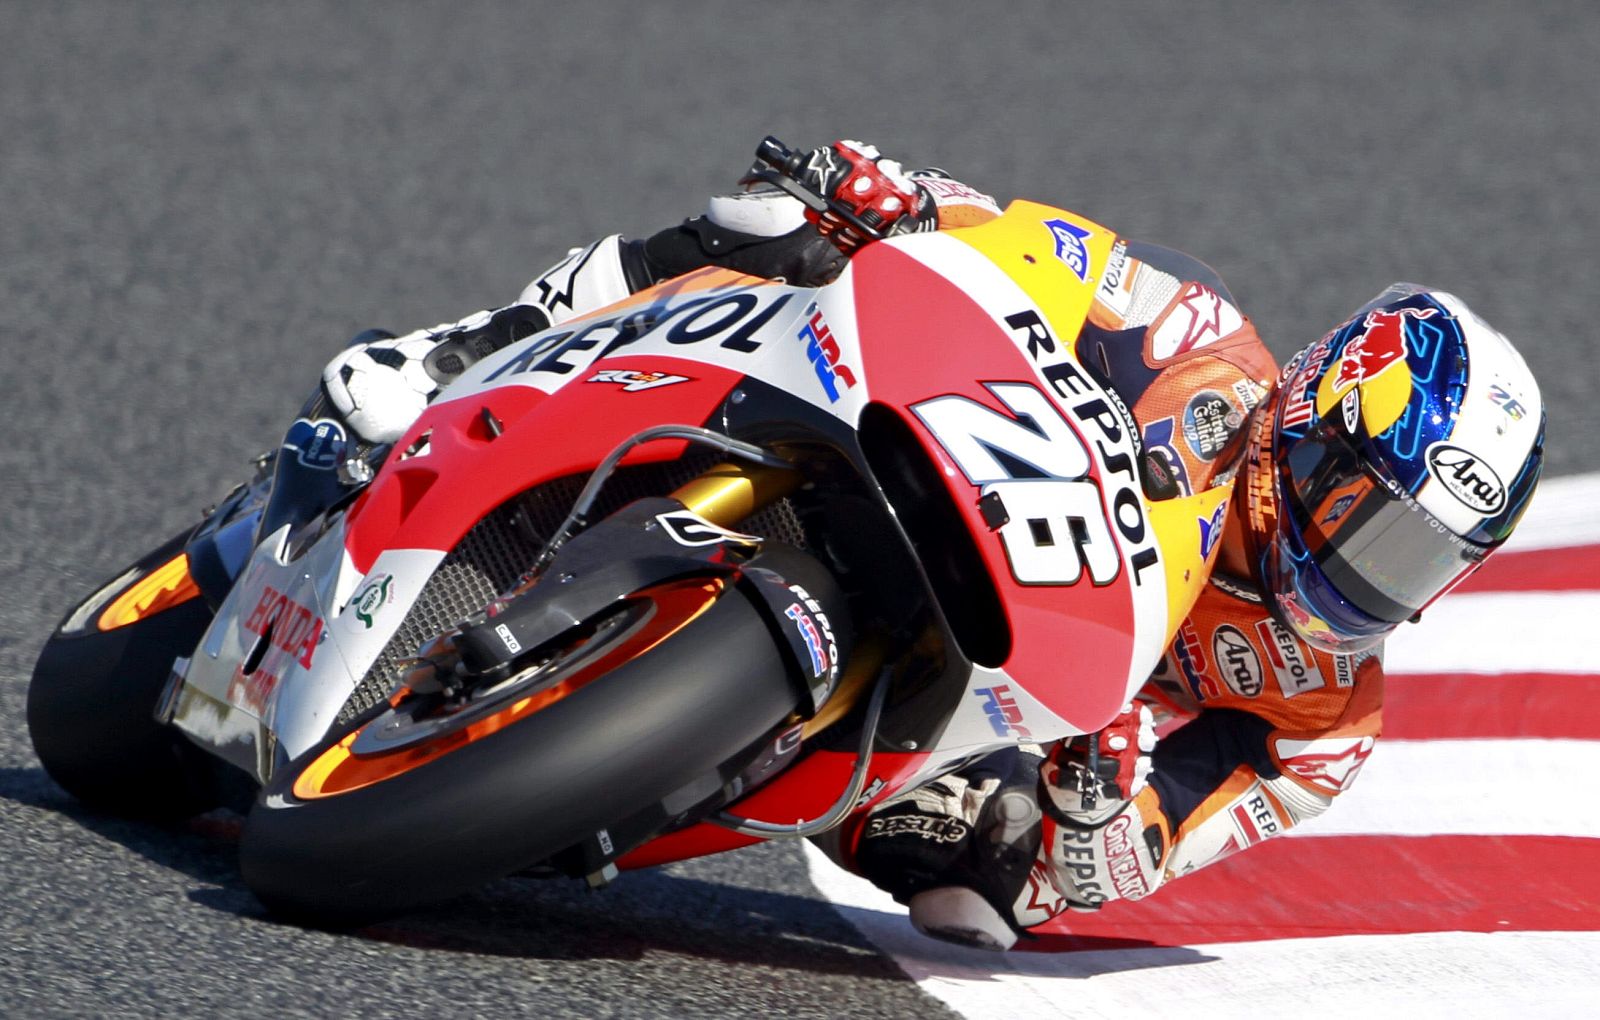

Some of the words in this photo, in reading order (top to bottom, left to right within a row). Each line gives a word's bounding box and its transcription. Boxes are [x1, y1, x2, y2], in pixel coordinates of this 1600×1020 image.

[798, 310, 858, 405] HRC
[1105, 386, 1142, 458] HONDA
[1193, 405, 1213, 454] Galicia
[1207, 399, 1229, 452] Estrella
[1488, 384, 1527, 421] 26
[1003, 309, 1159, 587] REPSOL
[1431, 452, 1503, 507] Arai
[904, 379, 1122, 589] 26
[1387, 479, 1421, 513] GIVES
[1423, 512, 1448, 535] YOU
[244, 586, 324, 671] HONDA
[784, 602, 828, 679] HRC
[788, 585, 839, 680] REPSOL
[1270, 619, 1309, 689] REPSOL
[1215, 631, 1263, 697] Arai
[973, 684, 1032, 738] HRC
[1247, 795, 1279, 838] REP
